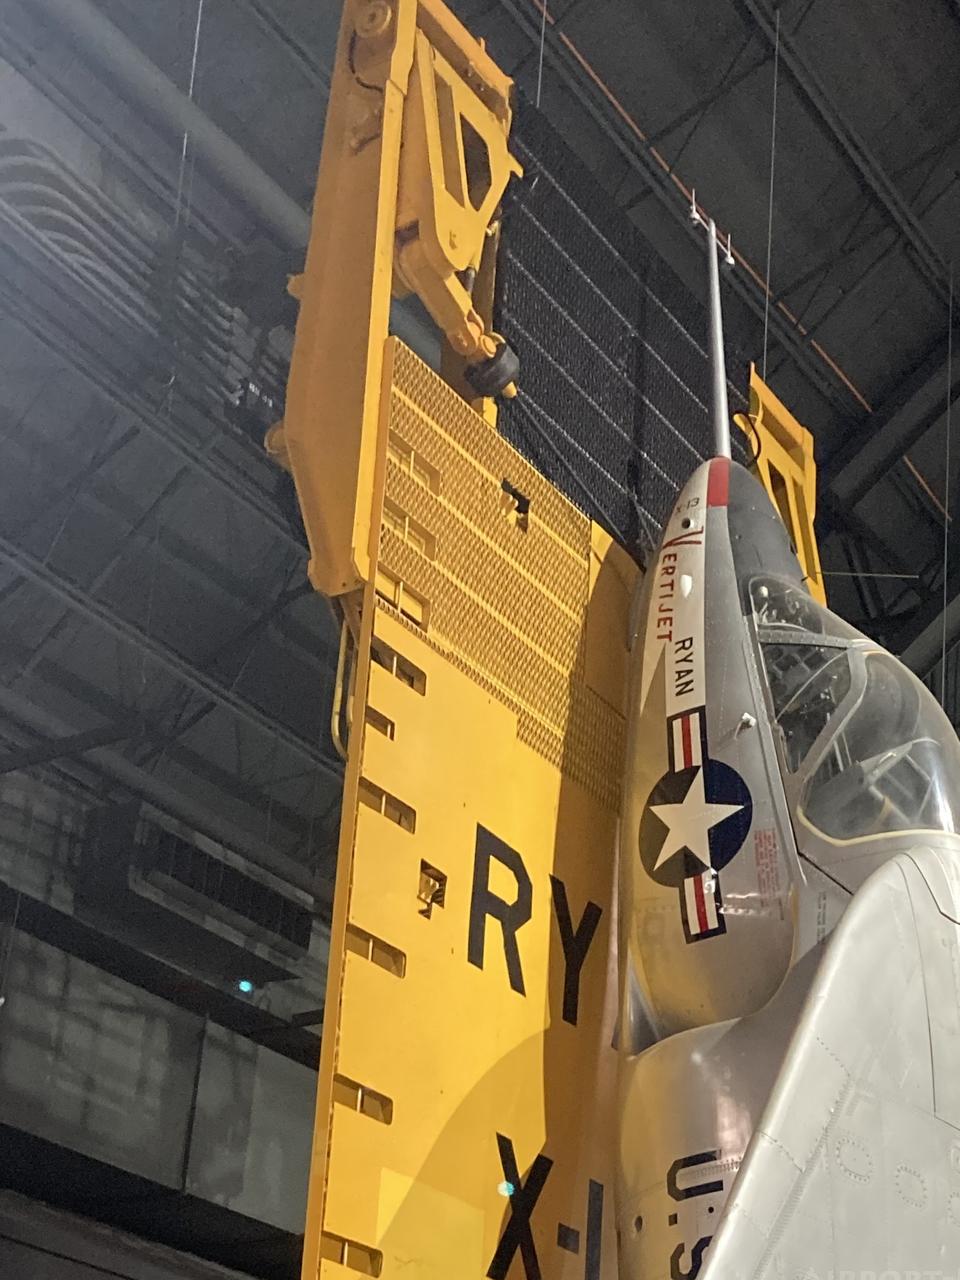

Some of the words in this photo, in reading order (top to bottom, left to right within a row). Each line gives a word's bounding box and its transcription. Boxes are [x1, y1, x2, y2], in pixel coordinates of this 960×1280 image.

[656, 525, 704, 642] VERTIJET
[674, 636, 694, 697] RYAN
[467, 821, 603, 1027] RY
